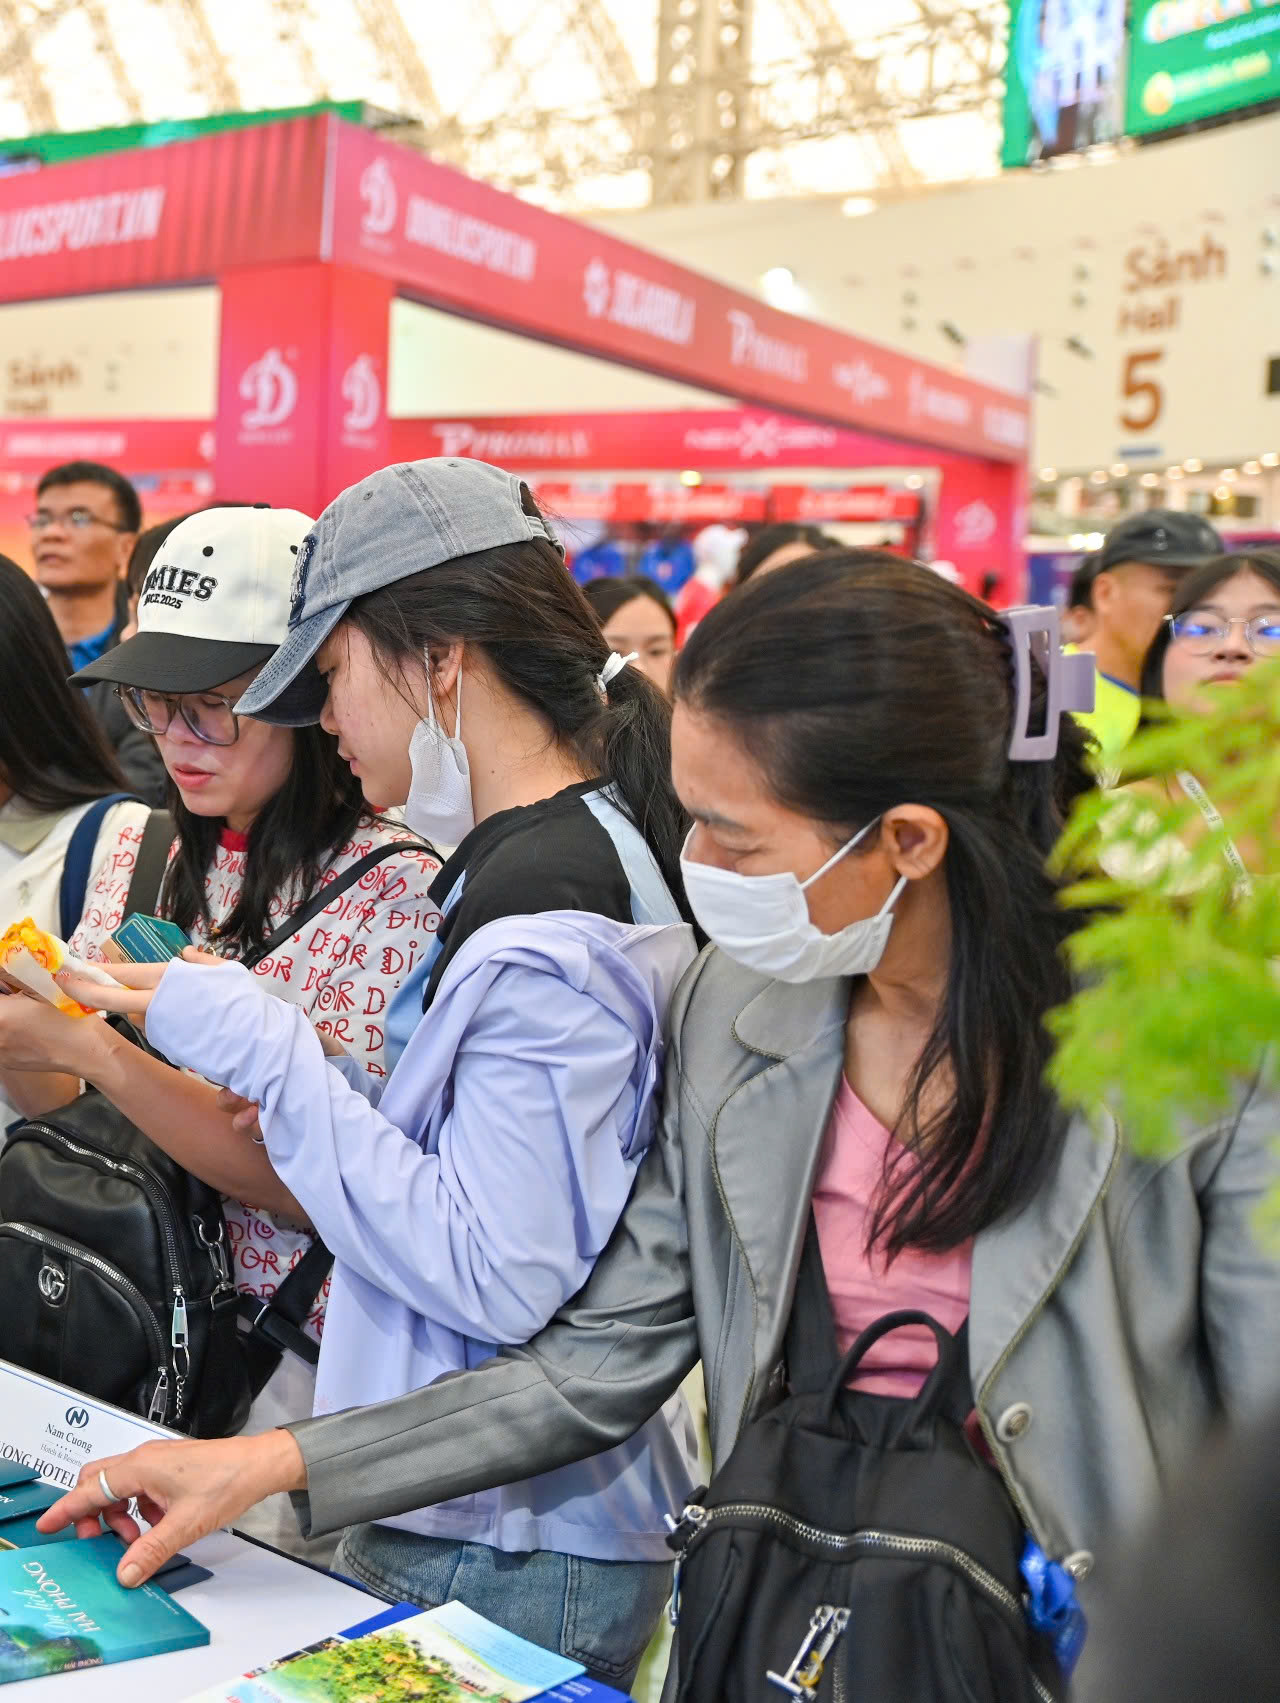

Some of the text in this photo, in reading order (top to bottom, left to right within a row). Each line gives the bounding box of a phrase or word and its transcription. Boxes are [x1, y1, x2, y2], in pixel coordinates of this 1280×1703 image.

[1119, 349, 1165, 433] 5
[142, 565, 218, 601] MIES
[161, 594, 183, 609] 2025
[40, 1443, 59, 1457] Hotels
[45, 1423, 93, 1454] Nam Cuong
